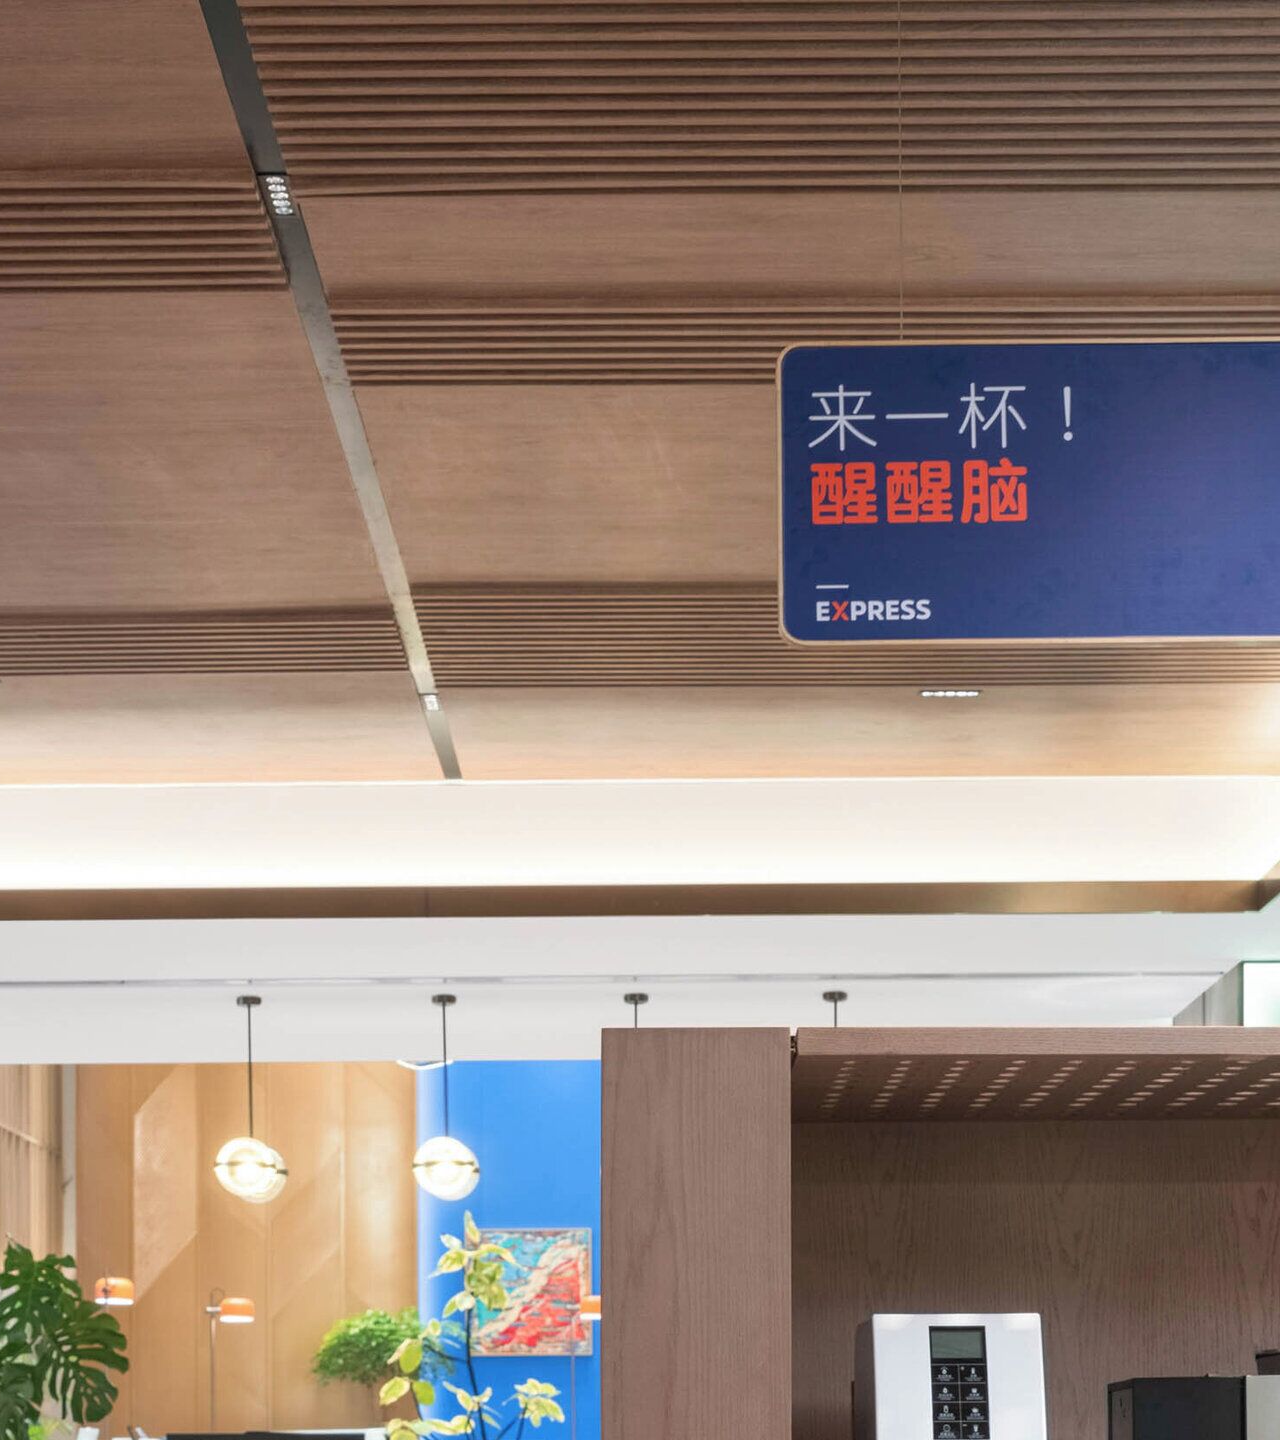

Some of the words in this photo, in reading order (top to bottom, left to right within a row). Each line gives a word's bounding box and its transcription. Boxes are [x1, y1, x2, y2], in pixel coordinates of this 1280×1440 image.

[808, 382, 1073, 451] 来一杯！
[810, 457, 1028, 525] 醒醒脑
[816, 599, 931, 622] EXPRESS
